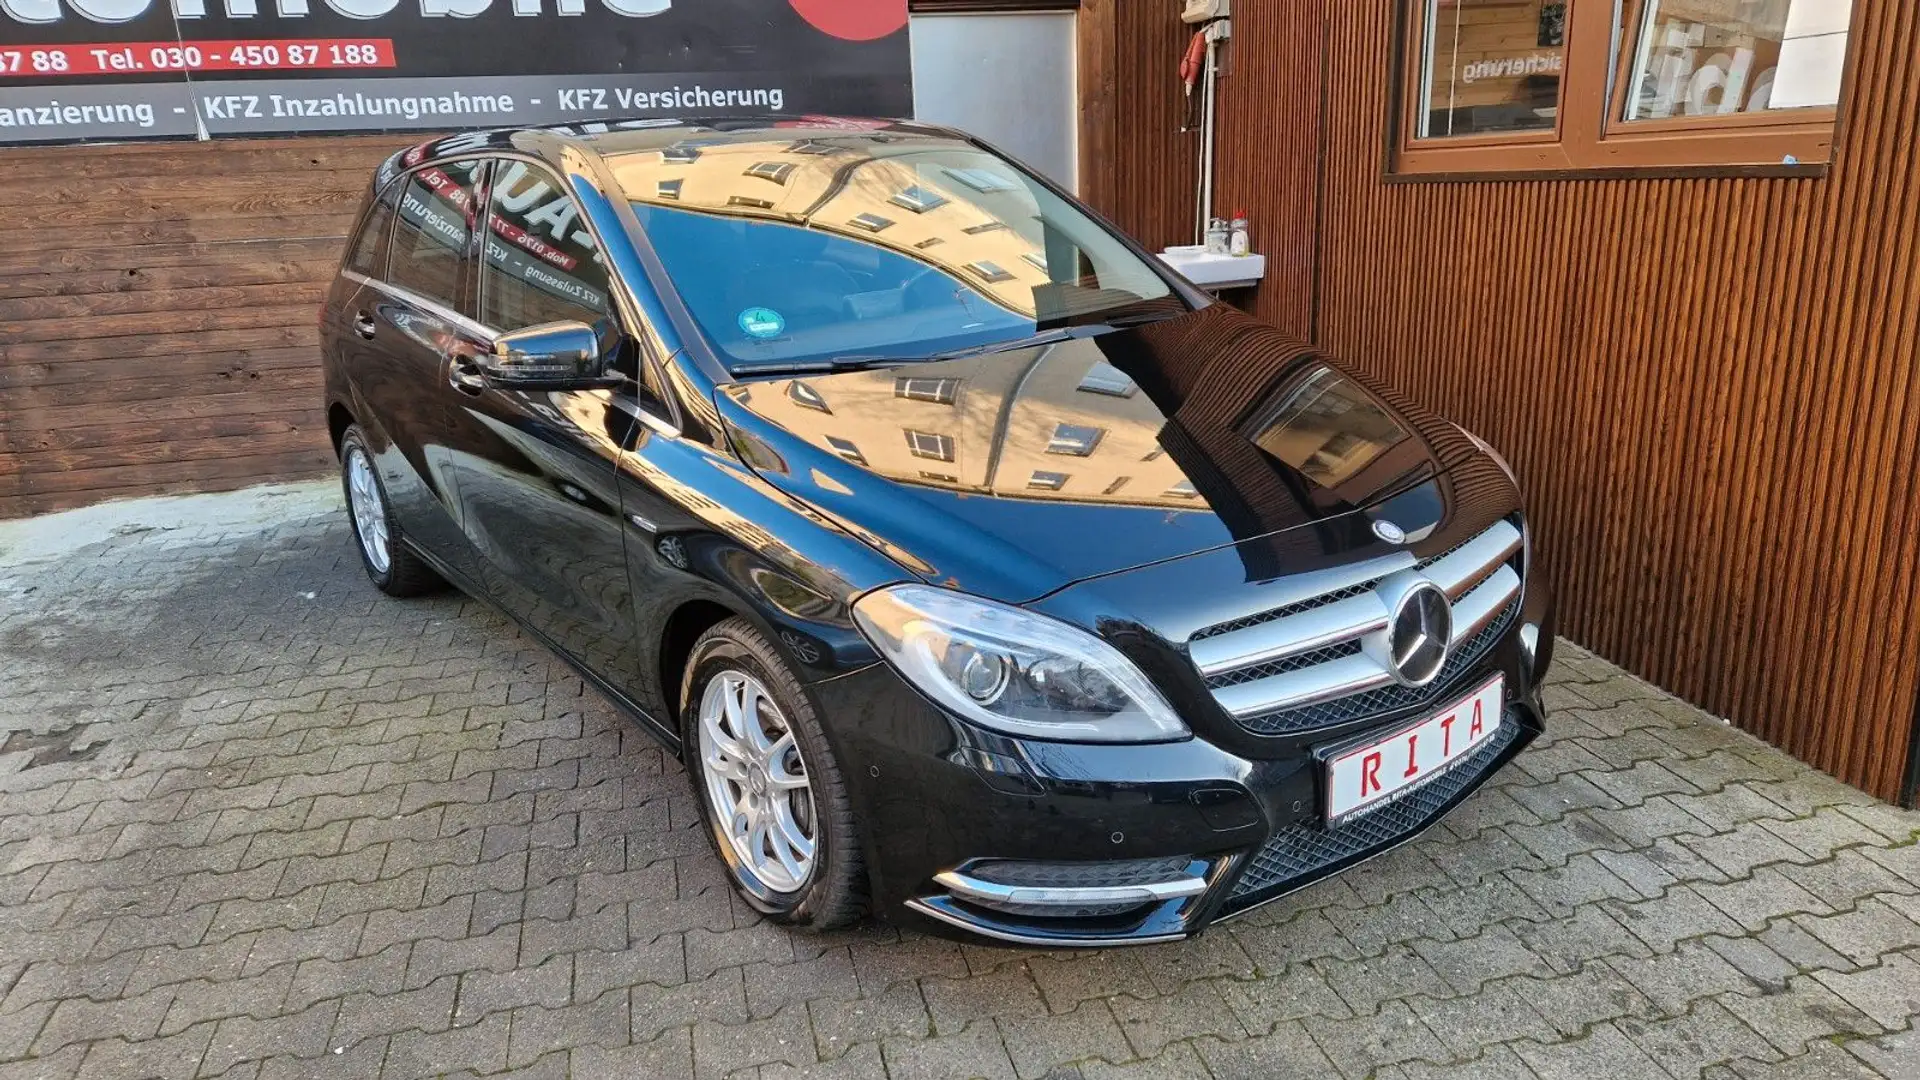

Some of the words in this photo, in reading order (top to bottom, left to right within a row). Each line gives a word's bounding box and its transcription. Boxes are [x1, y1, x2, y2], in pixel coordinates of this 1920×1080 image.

[0, 51, 21, 72] 7
[31, 50, 69, 72] 88
[91, 48, 144, 70] Tel.
[151, 46, 202, 68] 030
[230, 46, 280, 66] 450
[287, 45, 319, 65] 87
[330, 44, 378, 65] 188
[204, 96, 263, 119] KFZ
[269, 91, 514, 119] Inzahlungnahme
[558, 88, 608, 111] KFZ
[614, 86, 784, 111] Versicherung
[1342, 796, 1391, 825] AUTOHANDEL
